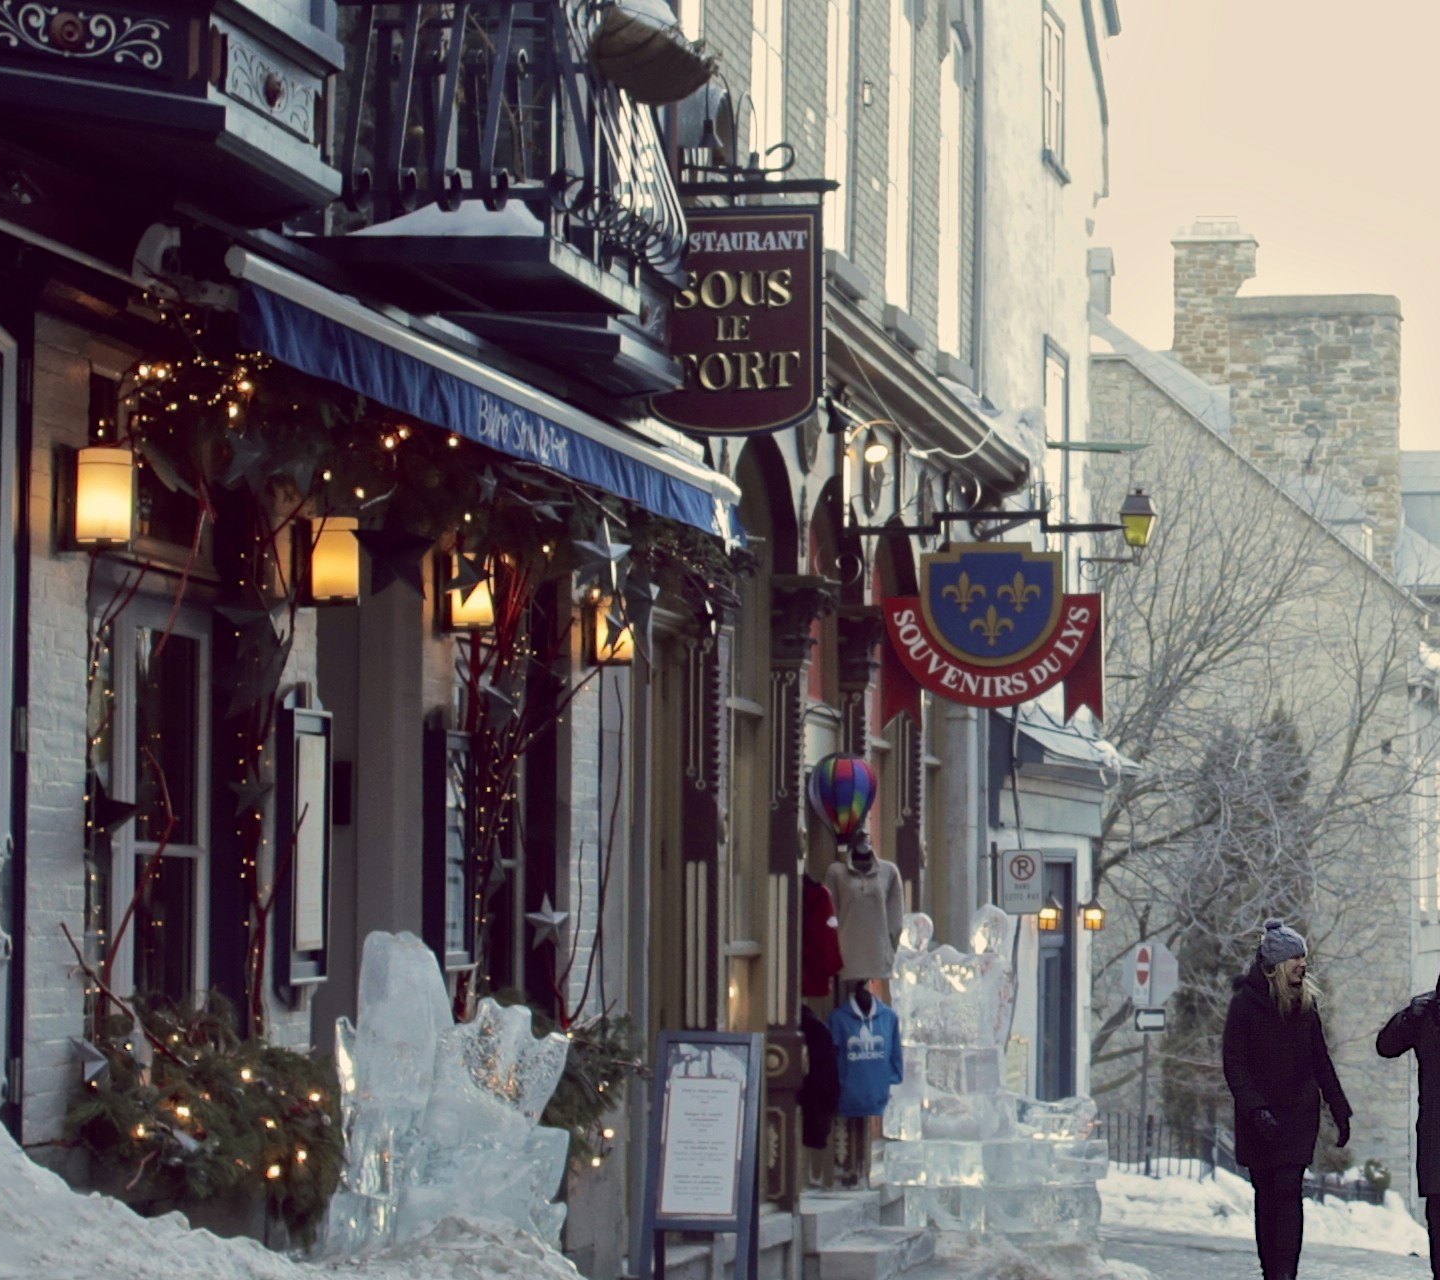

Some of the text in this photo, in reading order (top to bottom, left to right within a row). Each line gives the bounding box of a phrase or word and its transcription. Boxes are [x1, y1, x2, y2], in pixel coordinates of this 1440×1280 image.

[689, 230, 808, 254] STAURANT
[673, 267, 793, 310] SOUS
[715, 315, 751, 341] LE
[891, 605, 1091, 699] SOUVENIRS DU LYS
